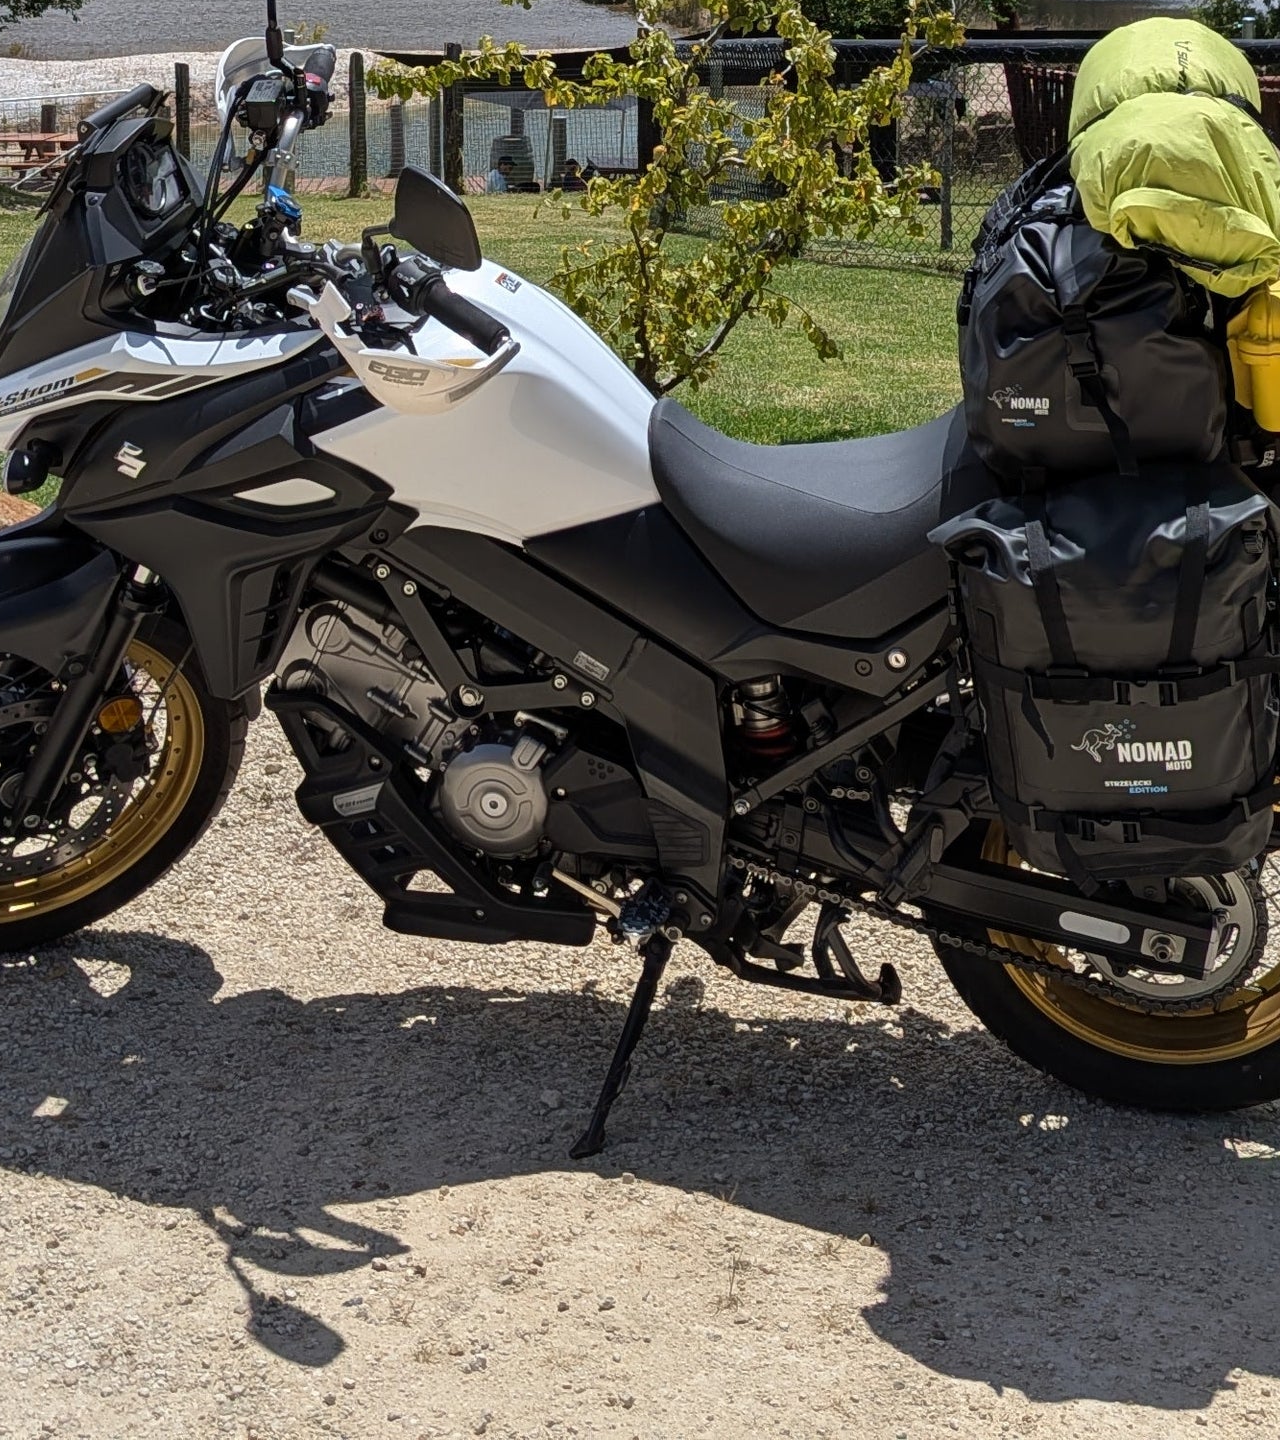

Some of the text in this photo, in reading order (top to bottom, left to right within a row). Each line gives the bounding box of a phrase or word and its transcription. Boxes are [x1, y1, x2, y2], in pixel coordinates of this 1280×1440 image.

[368, 360, 430, 381] EGO
[1011, 397, 1050, 409] NOMAD
[1117, 740, 1192, 762] NOMAD
[1166, 760, 1192, 771] MOTO
[1129, 786, 1168, 794] EDITION
